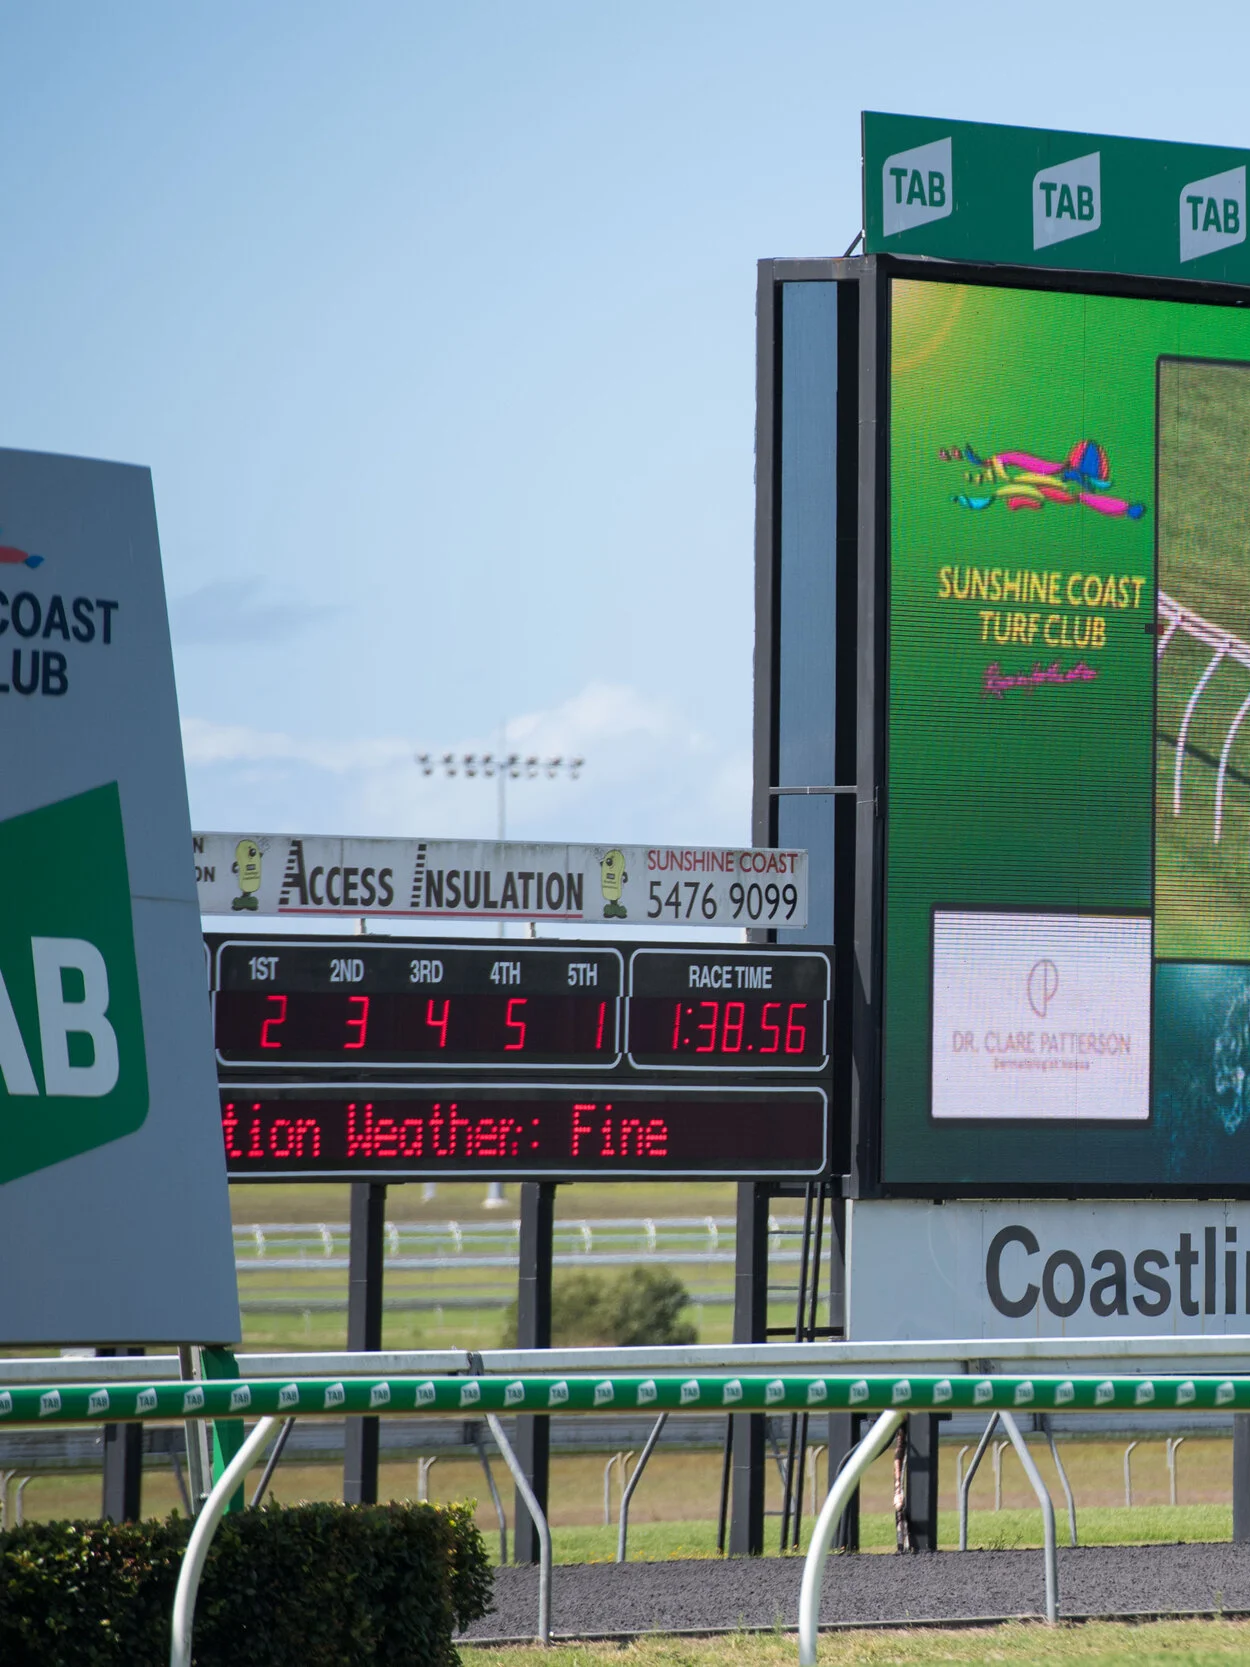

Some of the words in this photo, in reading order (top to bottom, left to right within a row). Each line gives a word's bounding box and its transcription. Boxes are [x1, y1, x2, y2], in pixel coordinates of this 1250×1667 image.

[889, 167, 946, 208] TAB
[1039, 181, 1094, 222] TAB
[1186, 195, 1240, 235] TAB
[937, 566, 1061, 605] SUNSHINE
[1066, 572, 1147, 609] COAST
[979, 610, 1041, 646] TURF
[1044, 614, 1106, 648] CLUB
[278, 840, 394, 908] ACCESS
[410, 843, 584, 912] INSULATION
[647, 849, 734, 872] SUNSHINE
[739, 852, 799, 874] COAST
[647, 880, 718, 920] 5476
[728, 882, 798, 921] 9099
[249, 956, 280, 981] 1ST
[330, 958, 365, 983] 2ND
[410, 960, 444, 984] 3RD
[489, 961, 522, 985] 4TH
[567, 963, 598, 986] 5TH
[688, 965, 732, 989] RACE
[736, 966, 773, 989] TIME
[260, 994, 288, 1048] 2
[343, 995, 370, 1049] 3
[426, 999, 450, 1048] 4
[504, 998, 528, 1051] 5
[595, 1001, 607, 1050] 1
[672, 1001, 808, 1054] 1:38.56
[952, 1030, 979, 1054] DR.
[984, 1031, 1034, 1054] CLARE
[1041, 1032, 1131, 1056] PATTERSON
[571, 1103, 668, 1157] Fine
